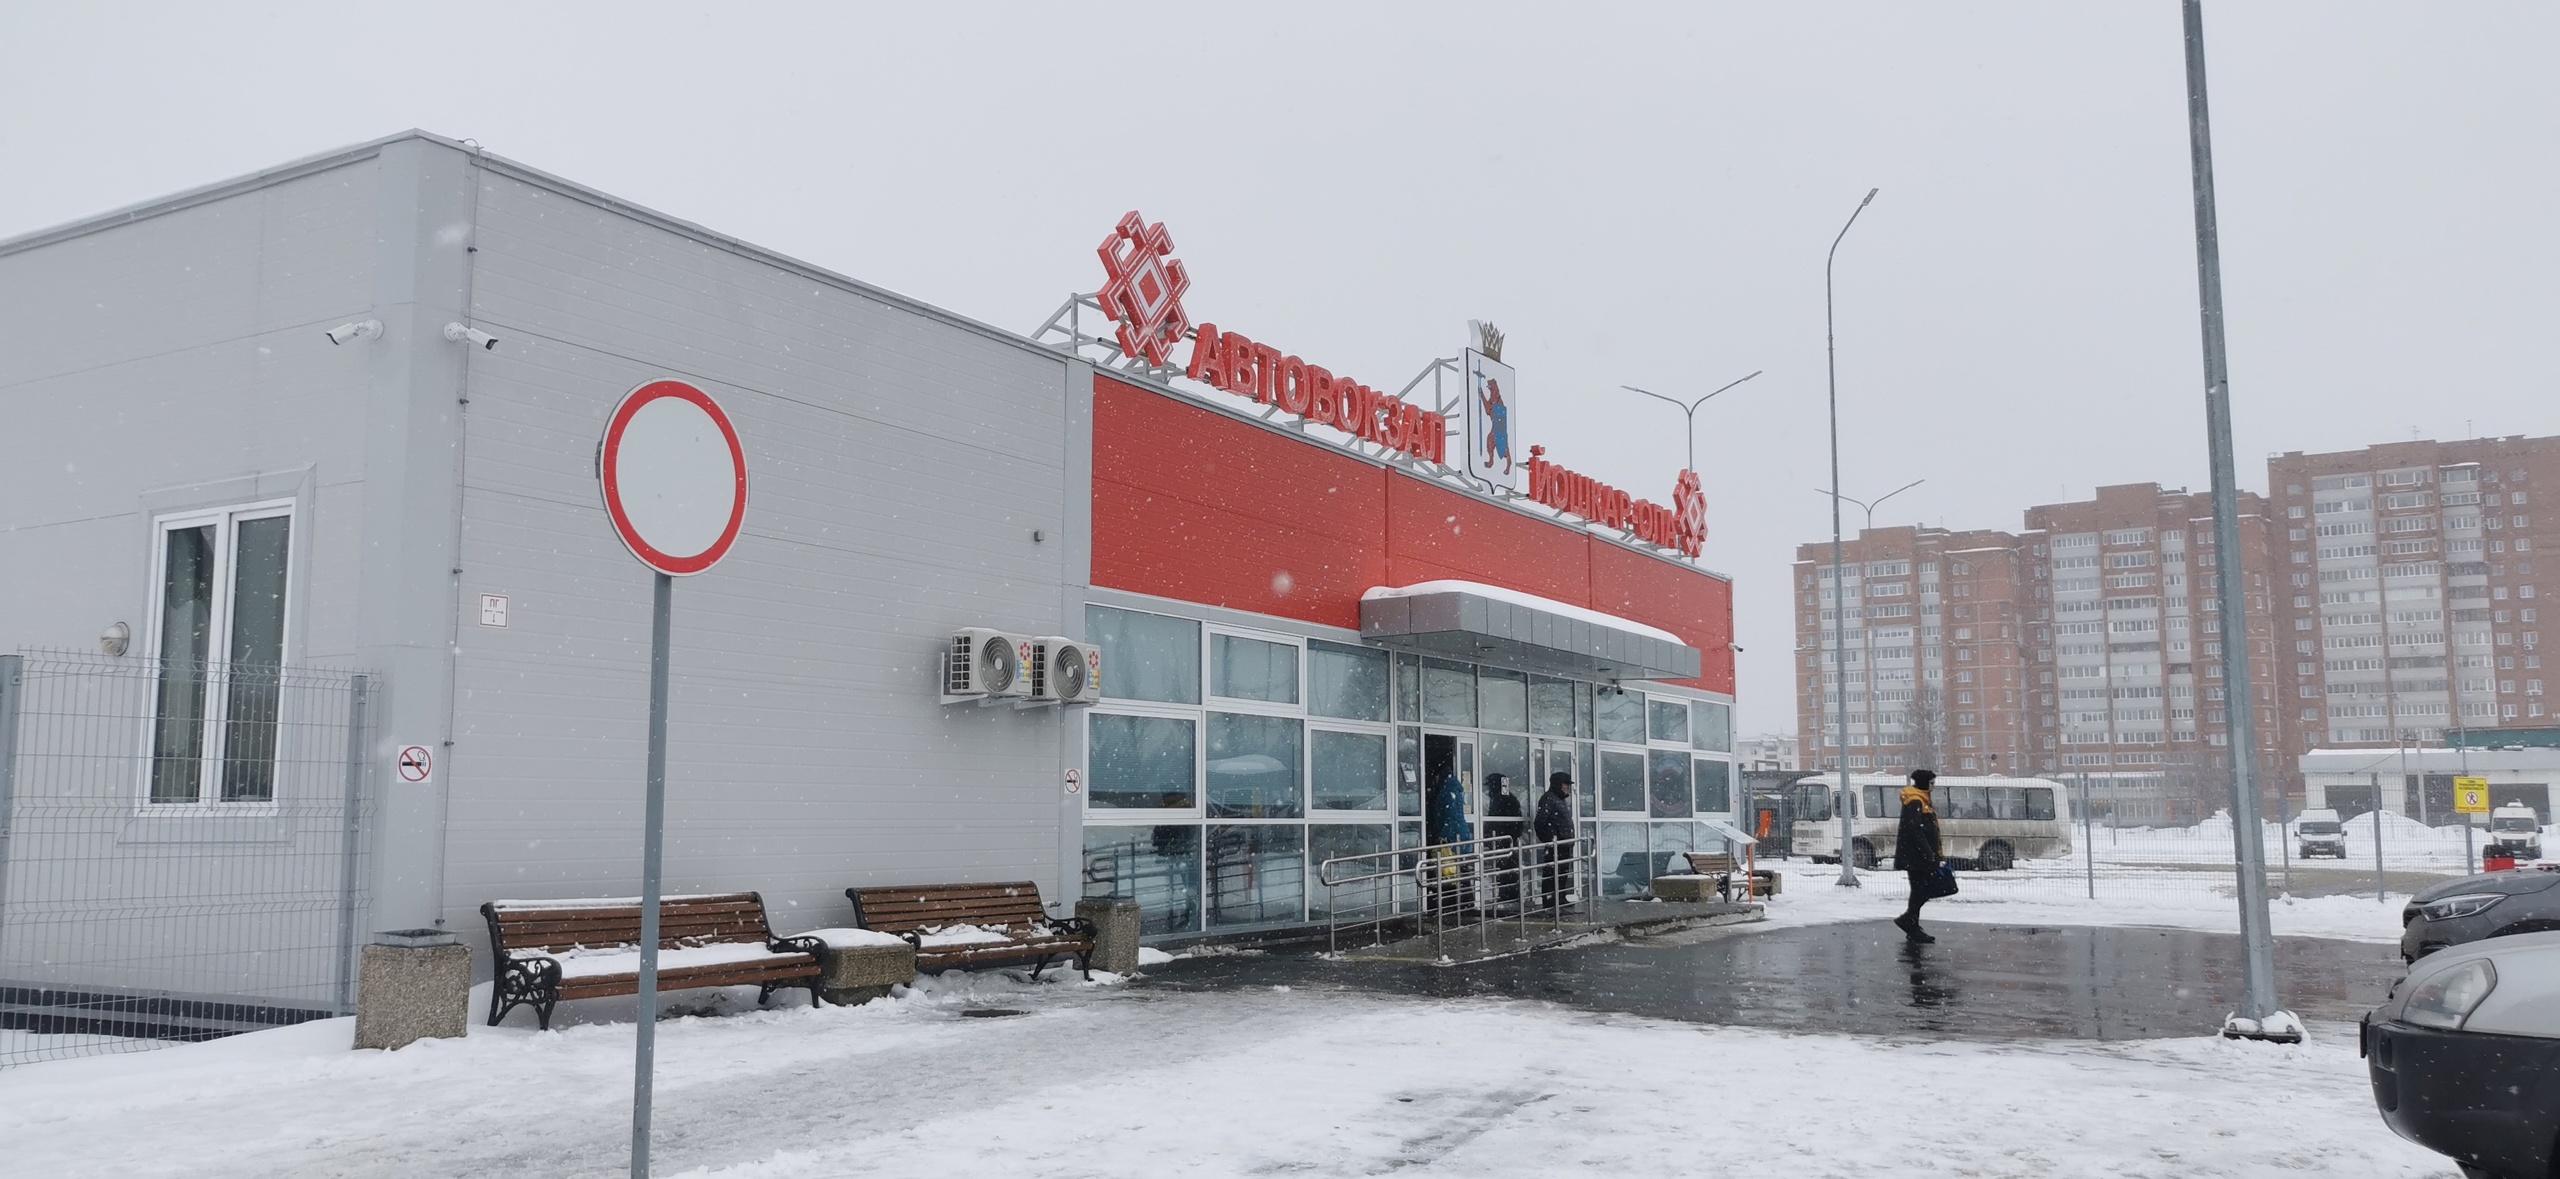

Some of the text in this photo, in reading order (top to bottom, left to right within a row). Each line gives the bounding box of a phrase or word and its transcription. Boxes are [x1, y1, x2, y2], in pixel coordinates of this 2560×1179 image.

[1187, 322, 1679, 549] АВТОВОКЗАЛ ЙОШКАР-ОЛА
[489, 598, 500, 608] ПГ
